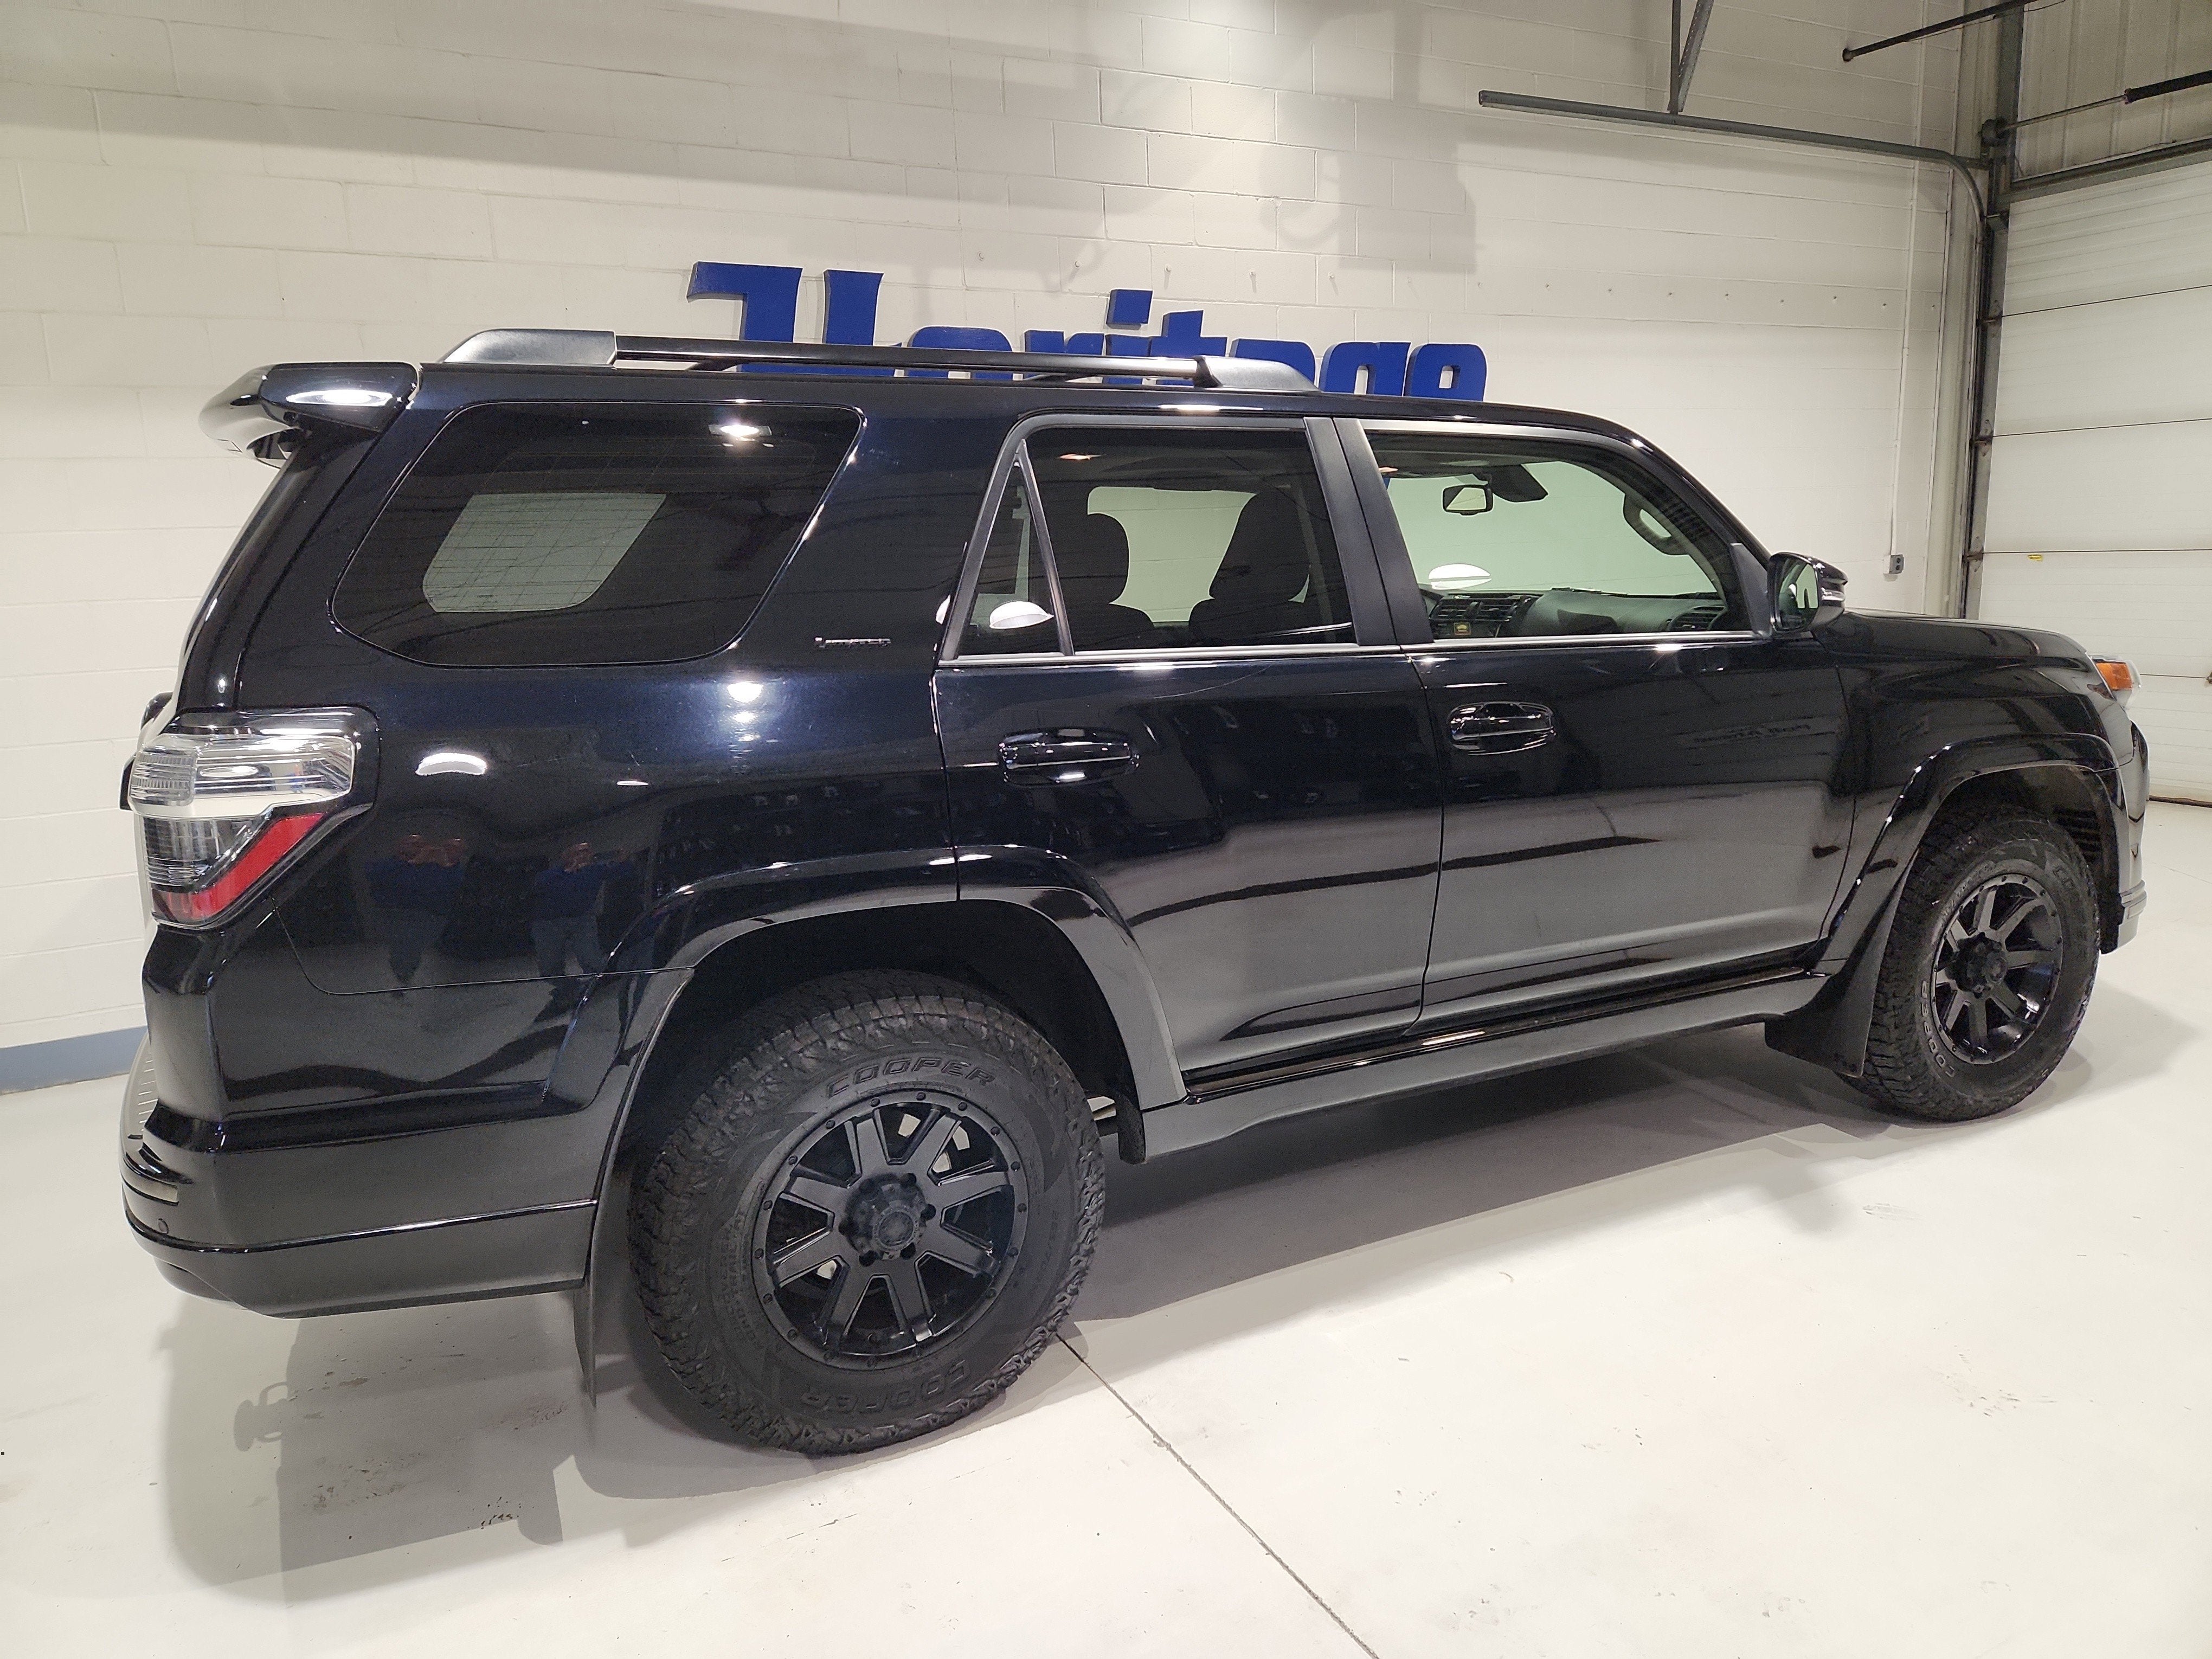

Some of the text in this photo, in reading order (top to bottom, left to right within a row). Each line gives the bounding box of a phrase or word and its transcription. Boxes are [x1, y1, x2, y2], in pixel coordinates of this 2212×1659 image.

[1921, 980, 1954, 1077] COOPER
[827, 1057, 995, 1099] COOPER
[800, 1359, 971, 1413] COOPER
